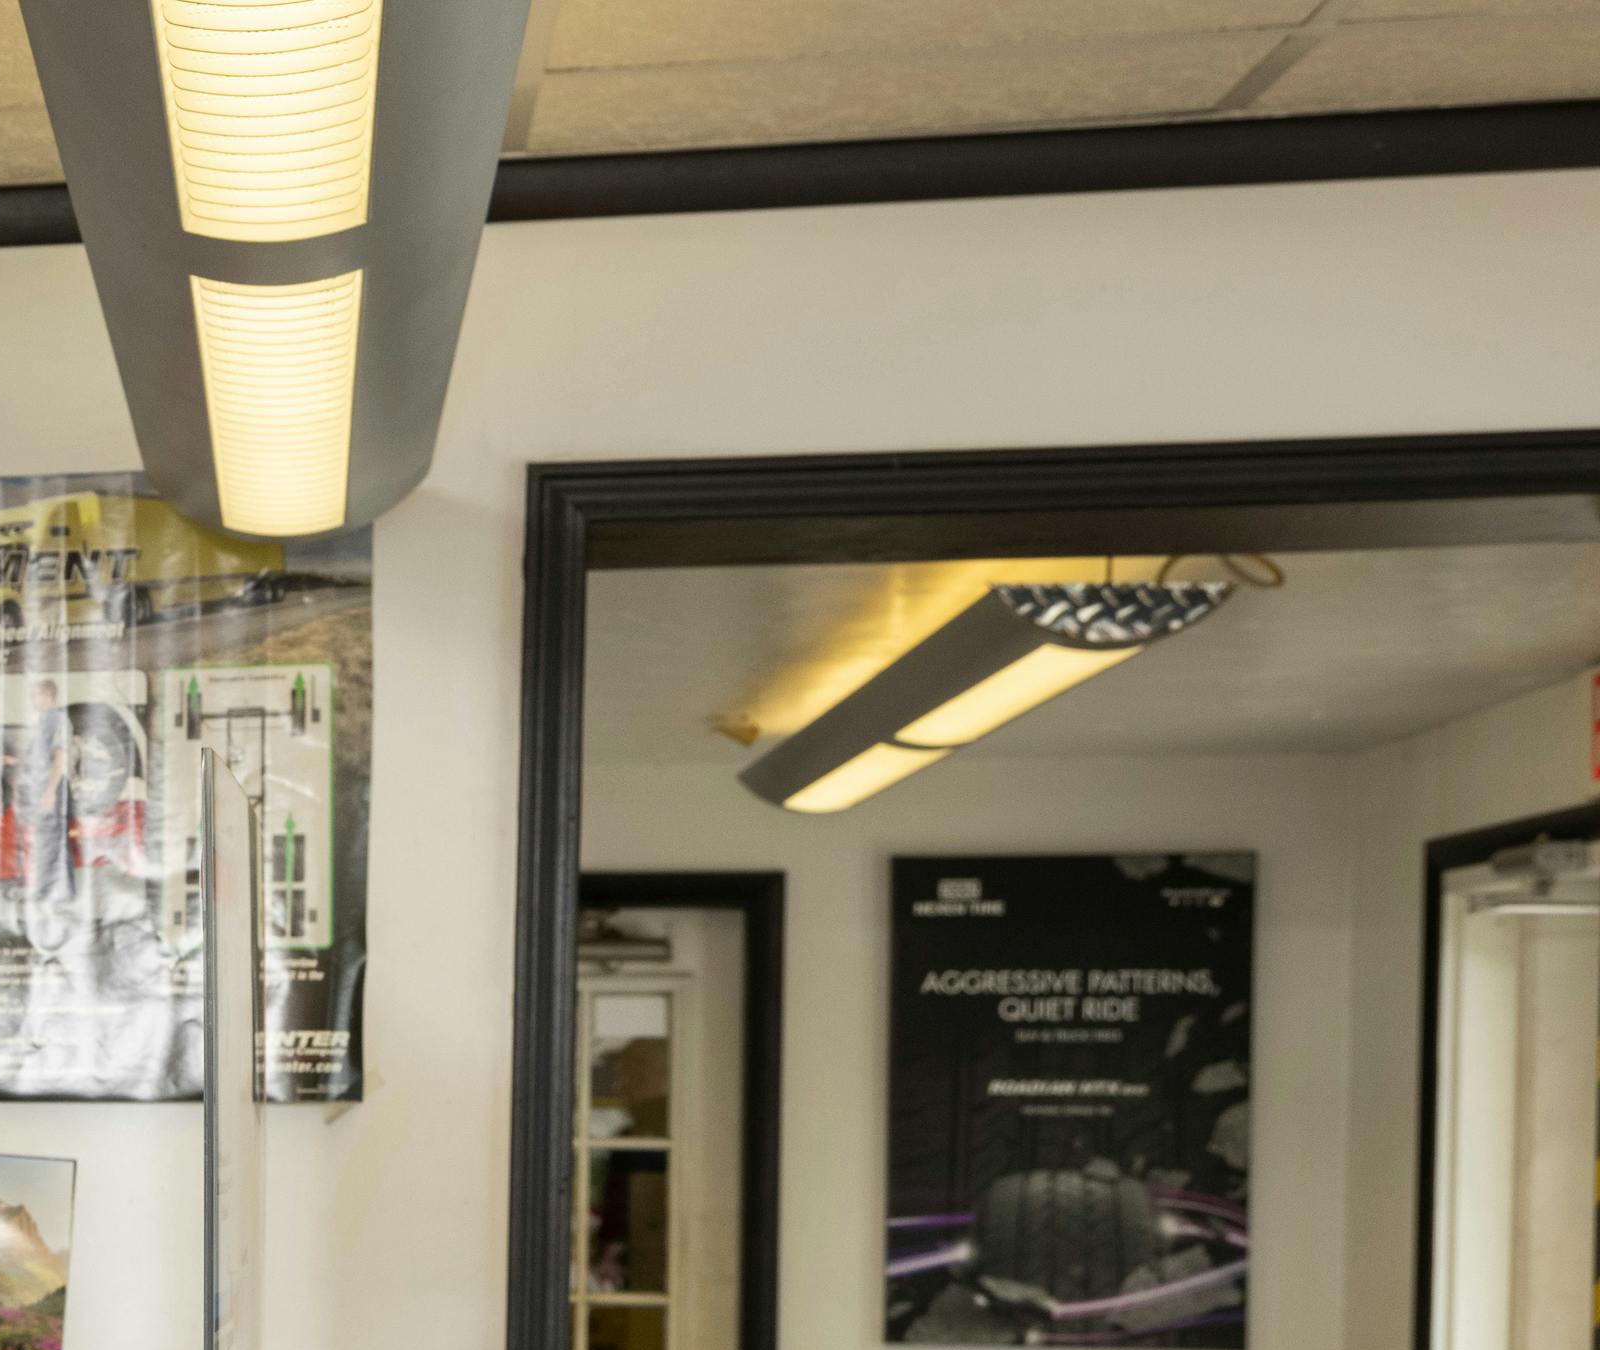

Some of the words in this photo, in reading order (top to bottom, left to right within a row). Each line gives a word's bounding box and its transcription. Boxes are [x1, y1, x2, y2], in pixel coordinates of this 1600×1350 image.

[920, 968, 1084, 995] AGGRESSIVE
[1087, 968, 1222, 997] PATTERNS,
[997, 996, 1077, 1022] QUIET
[1081, 996, 1141, 1022] RIDE
